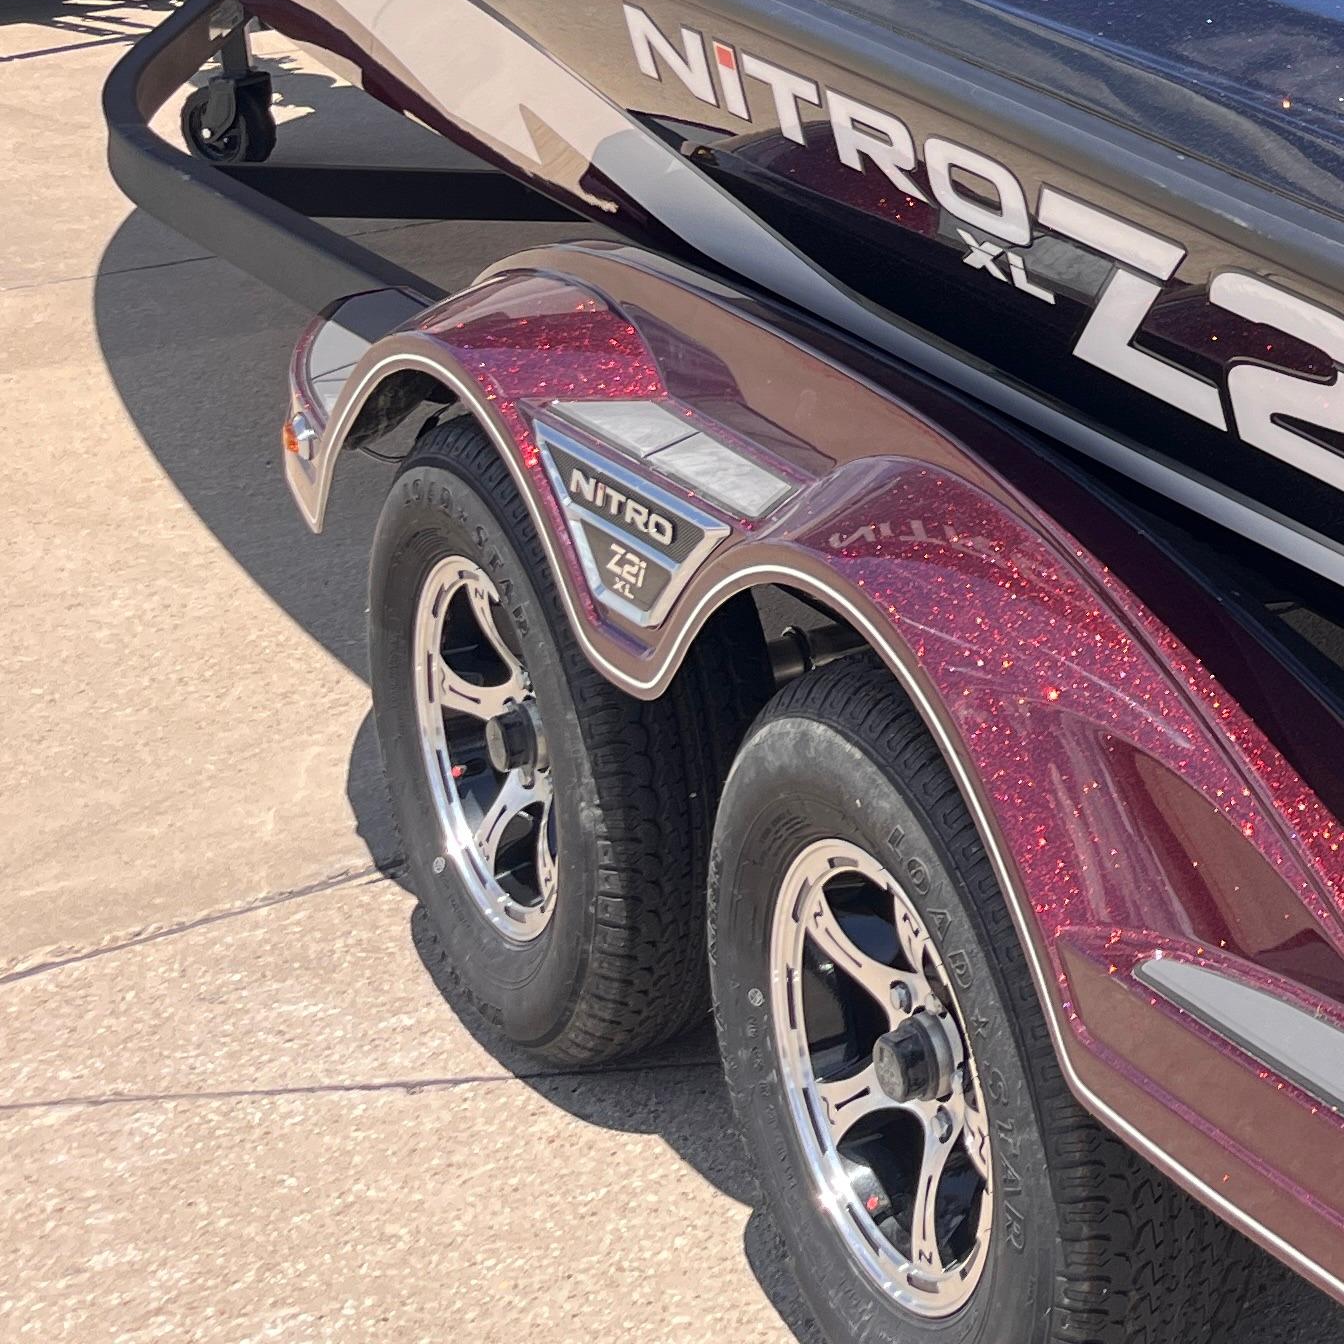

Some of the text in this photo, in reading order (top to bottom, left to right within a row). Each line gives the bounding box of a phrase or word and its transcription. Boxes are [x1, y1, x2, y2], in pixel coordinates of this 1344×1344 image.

[955, 227, 1058, 305] XL
[606, 543, 647, 589] Z21
[612, 577, 635, 599] XL
[886, 825, 1027, 1257] LOAD STAR
